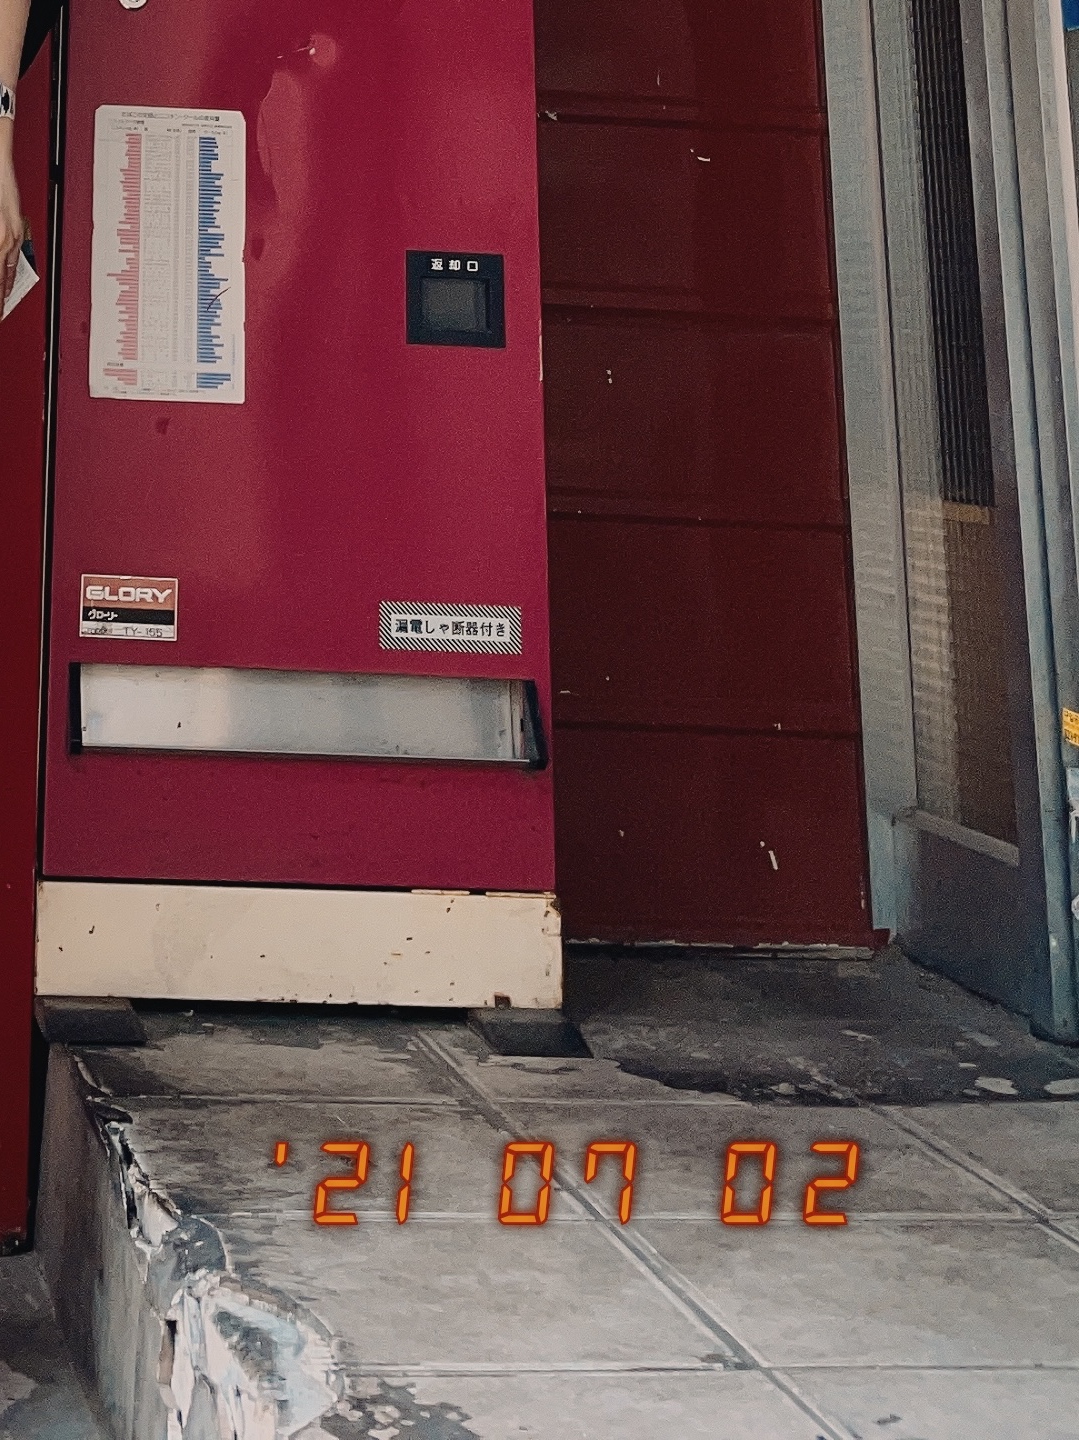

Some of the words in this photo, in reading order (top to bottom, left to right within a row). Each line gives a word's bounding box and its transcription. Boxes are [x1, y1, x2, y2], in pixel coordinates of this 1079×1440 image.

[430, 257, 479, 272] 返却口
[85, 585, 173, 604] GLORY
[395, 618, 506, 637] 漏電しゃ断器付き
